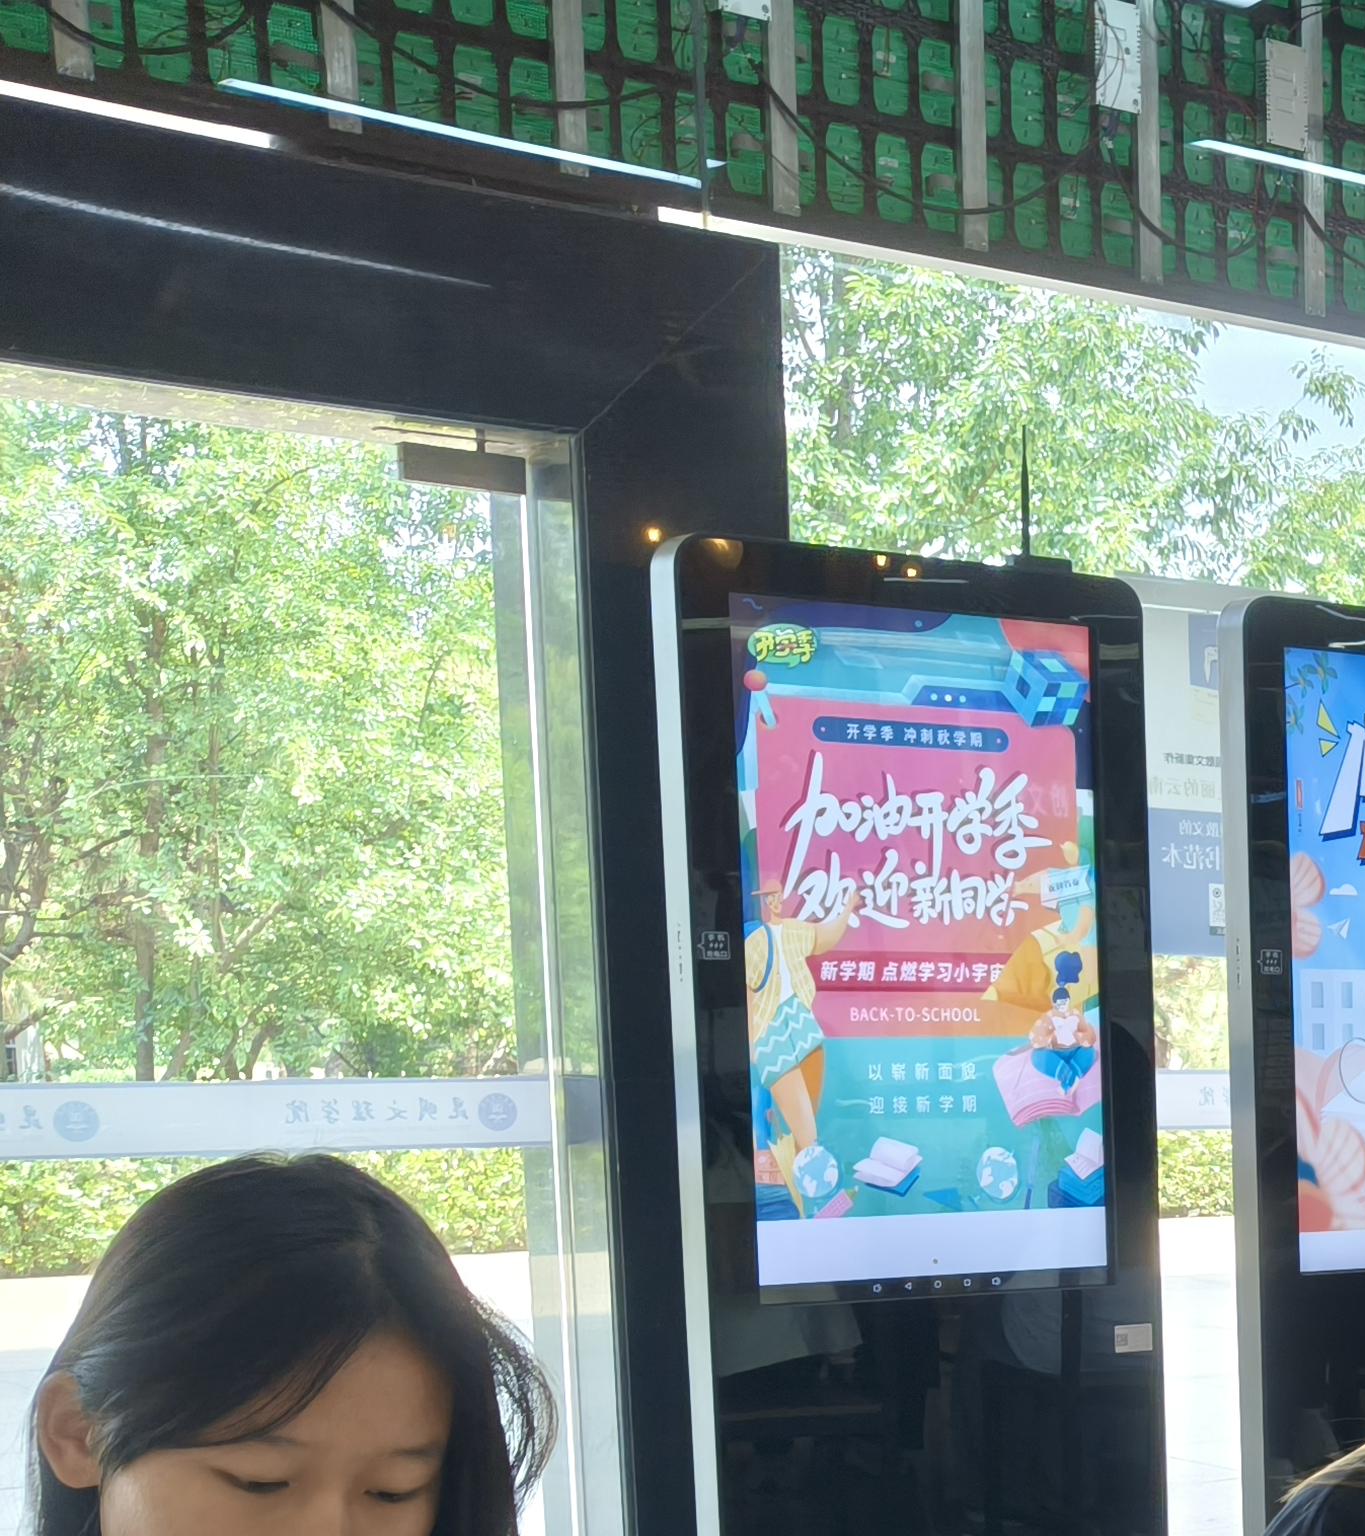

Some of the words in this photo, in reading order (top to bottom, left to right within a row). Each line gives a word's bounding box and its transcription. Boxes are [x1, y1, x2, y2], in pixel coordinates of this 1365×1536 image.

[847, 723, 894, 741] 开学季
[903, 726, 983, 748] 冲刺秋学期
[783, 751, 1053, 899] 加油开学季
[796, 849, 1029, 929] 欢迎新同学
[820, 961, 875, 982] 新学期
[881, 961, 1006, 983] 点燃学习小宇宙
[849, 1006, 981, 1023] BACK-TO-SCHOOL
[868, 1062, 977, 1081] 以崭新面貌
[868, 1095, 978, 1114] 迎接新学期
